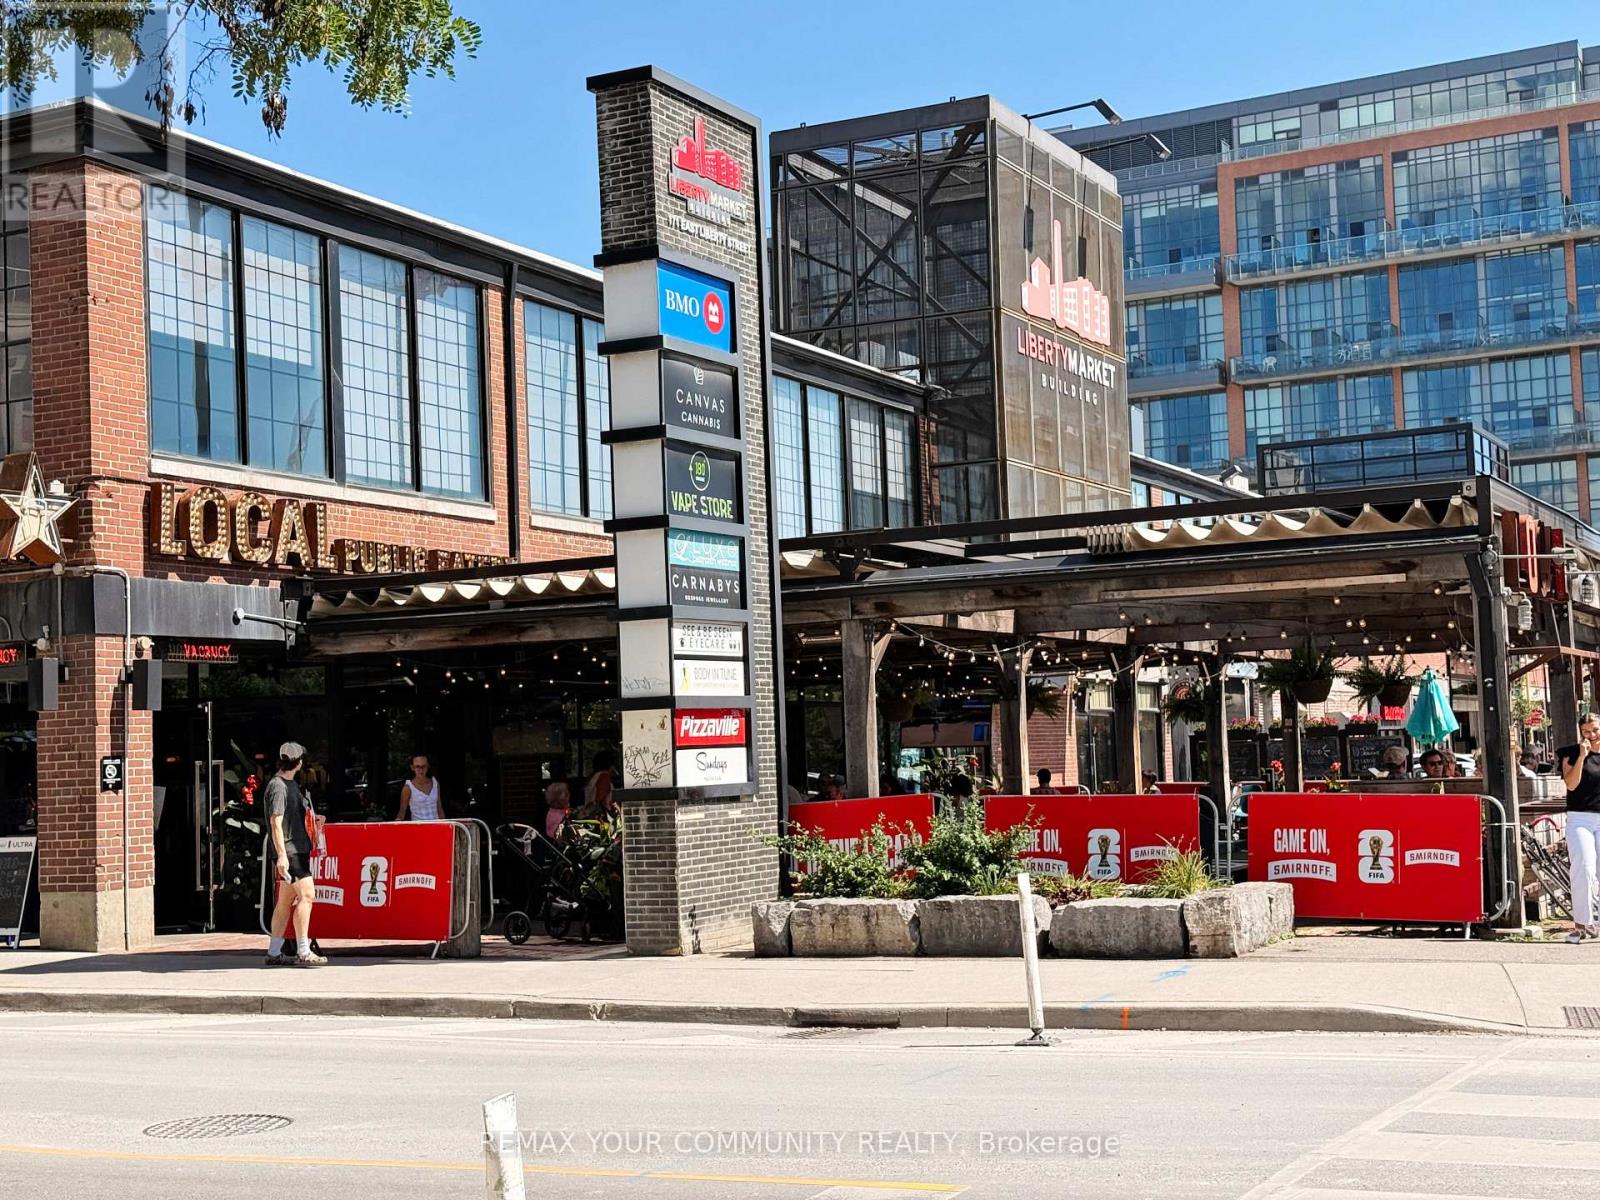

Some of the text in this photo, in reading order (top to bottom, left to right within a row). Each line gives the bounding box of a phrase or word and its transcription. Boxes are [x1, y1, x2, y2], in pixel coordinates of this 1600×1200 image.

[665, 289, 700, 317] BMO
[1041, 373, 1098, 405] BUILDING
[676, 388, 725, 413] CANVAS
[681, 411, 720, 430] CANNABIS
[671, 491, 734, 519] VAPE STORE
[150, 482, 339, 570] LOCAL
[334, 539, 429, 573] PUBLIC
[672, 574, 740, 594] CARNABYS
[682, 625, 695, 637] SEE
[703, 626, 712, 638] BE
[713, 627, 732, 638] SEEN
[184, 643, 231, 658] VACANCY
[689, 637, 725, 649] EYECARE
[680, 715, 740, 737] Pizzaville
[696, 751, 728, 773] Sundays
[12, 841, 34, 849] ULTRA
[1273, 827, 1330, 855] GAME ON,
[1409, 852, 1456, 863] SMIRNOFF
[398, 874, 433, 886] SMIRNOFF
[1273, 863, 1332, 877] SMIRNOFF
